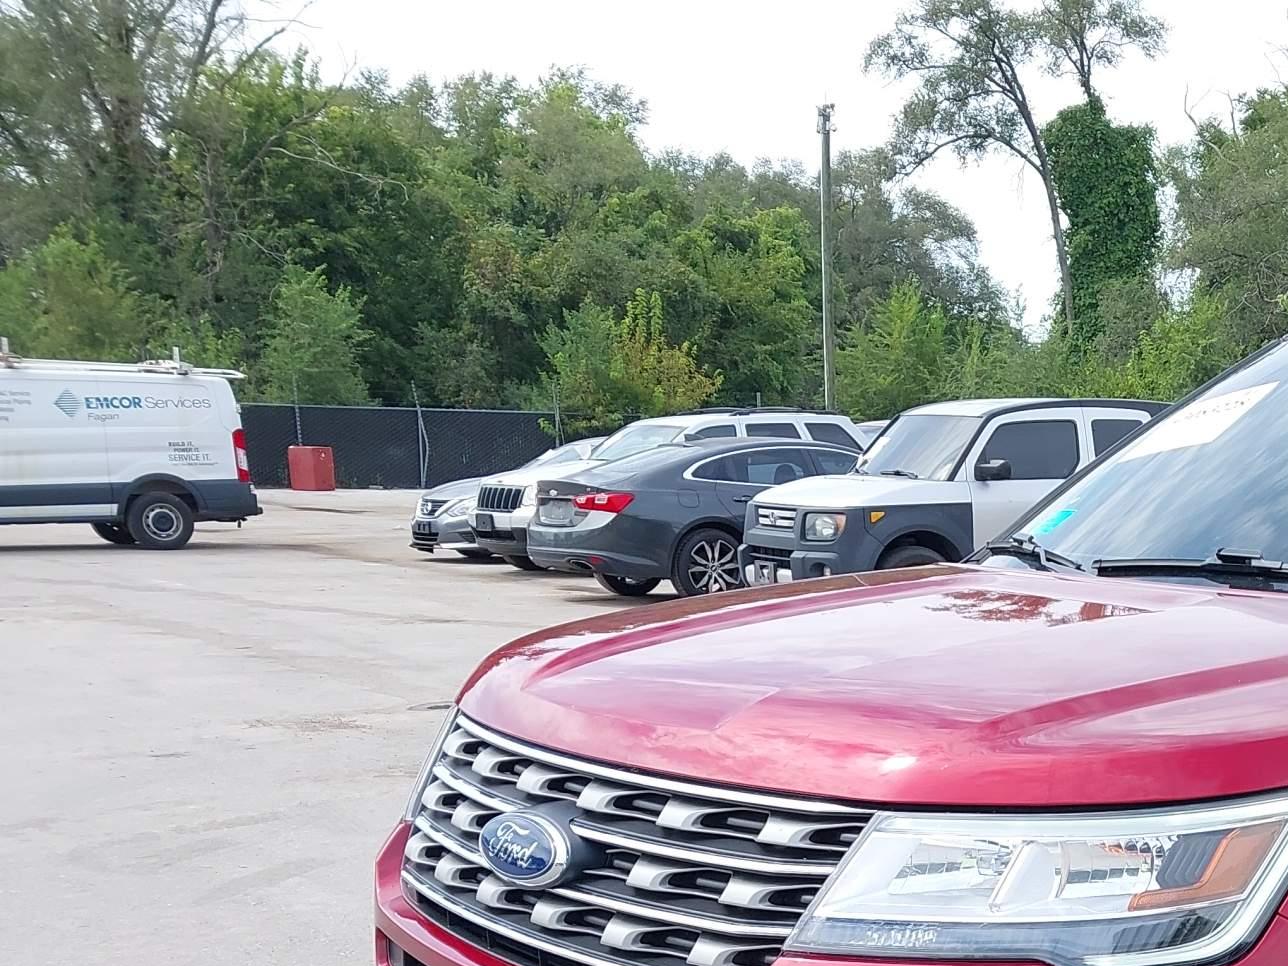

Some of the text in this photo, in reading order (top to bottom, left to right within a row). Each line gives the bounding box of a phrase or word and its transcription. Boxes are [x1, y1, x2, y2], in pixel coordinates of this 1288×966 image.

[85, 396, 212, 410] EMCOR Services
[88, 412, 119, 422] Fagan
[168, 453, 201, 461] SERVICE
[489, 821, 539, 868] Ford
